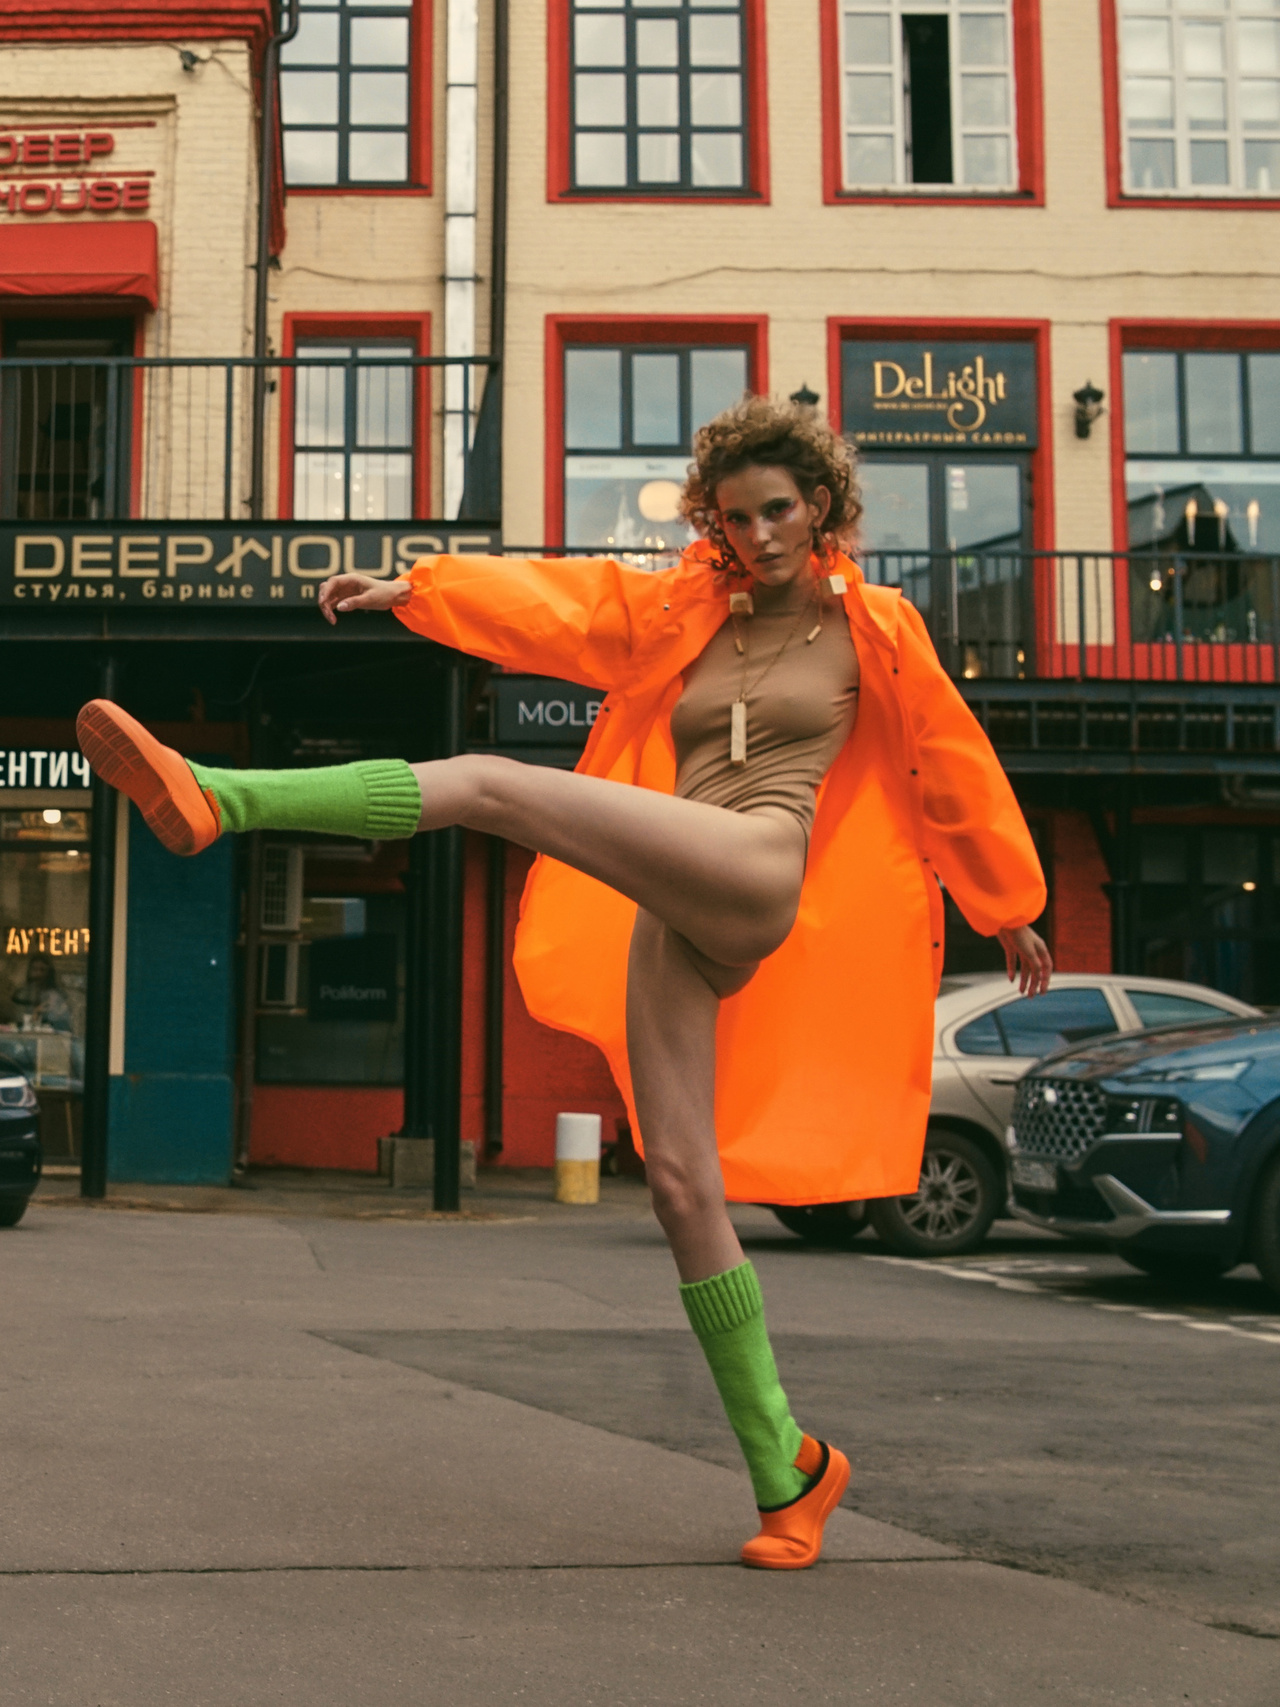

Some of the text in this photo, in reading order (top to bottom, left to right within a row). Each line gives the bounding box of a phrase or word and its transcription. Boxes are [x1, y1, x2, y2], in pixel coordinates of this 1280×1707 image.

[13, 583, 126, 601] стулья,
[141, 580, 254, 601] барные
[271, 584, 285, 598] и
